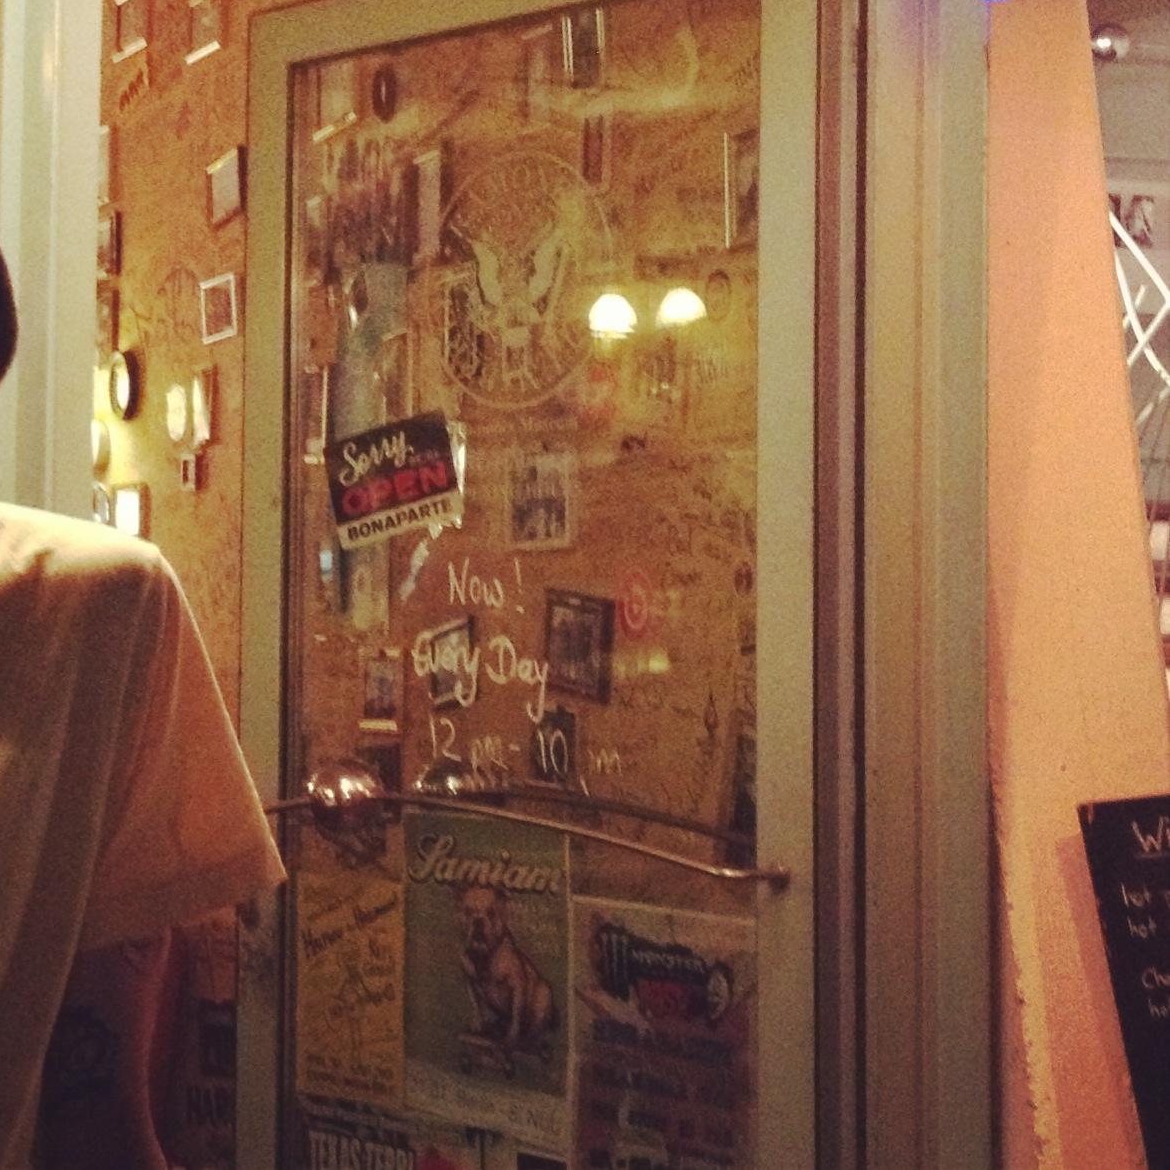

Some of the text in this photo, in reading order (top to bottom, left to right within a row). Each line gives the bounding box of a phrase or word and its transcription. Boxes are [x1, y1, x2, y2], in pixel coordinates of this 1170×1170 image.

[342, 461, 448, 515] OPEN
[347, 498, 452, 541] BONAPARTE
[484, 634, 549, 725] Day
[537, 728, 569, 775] 10
